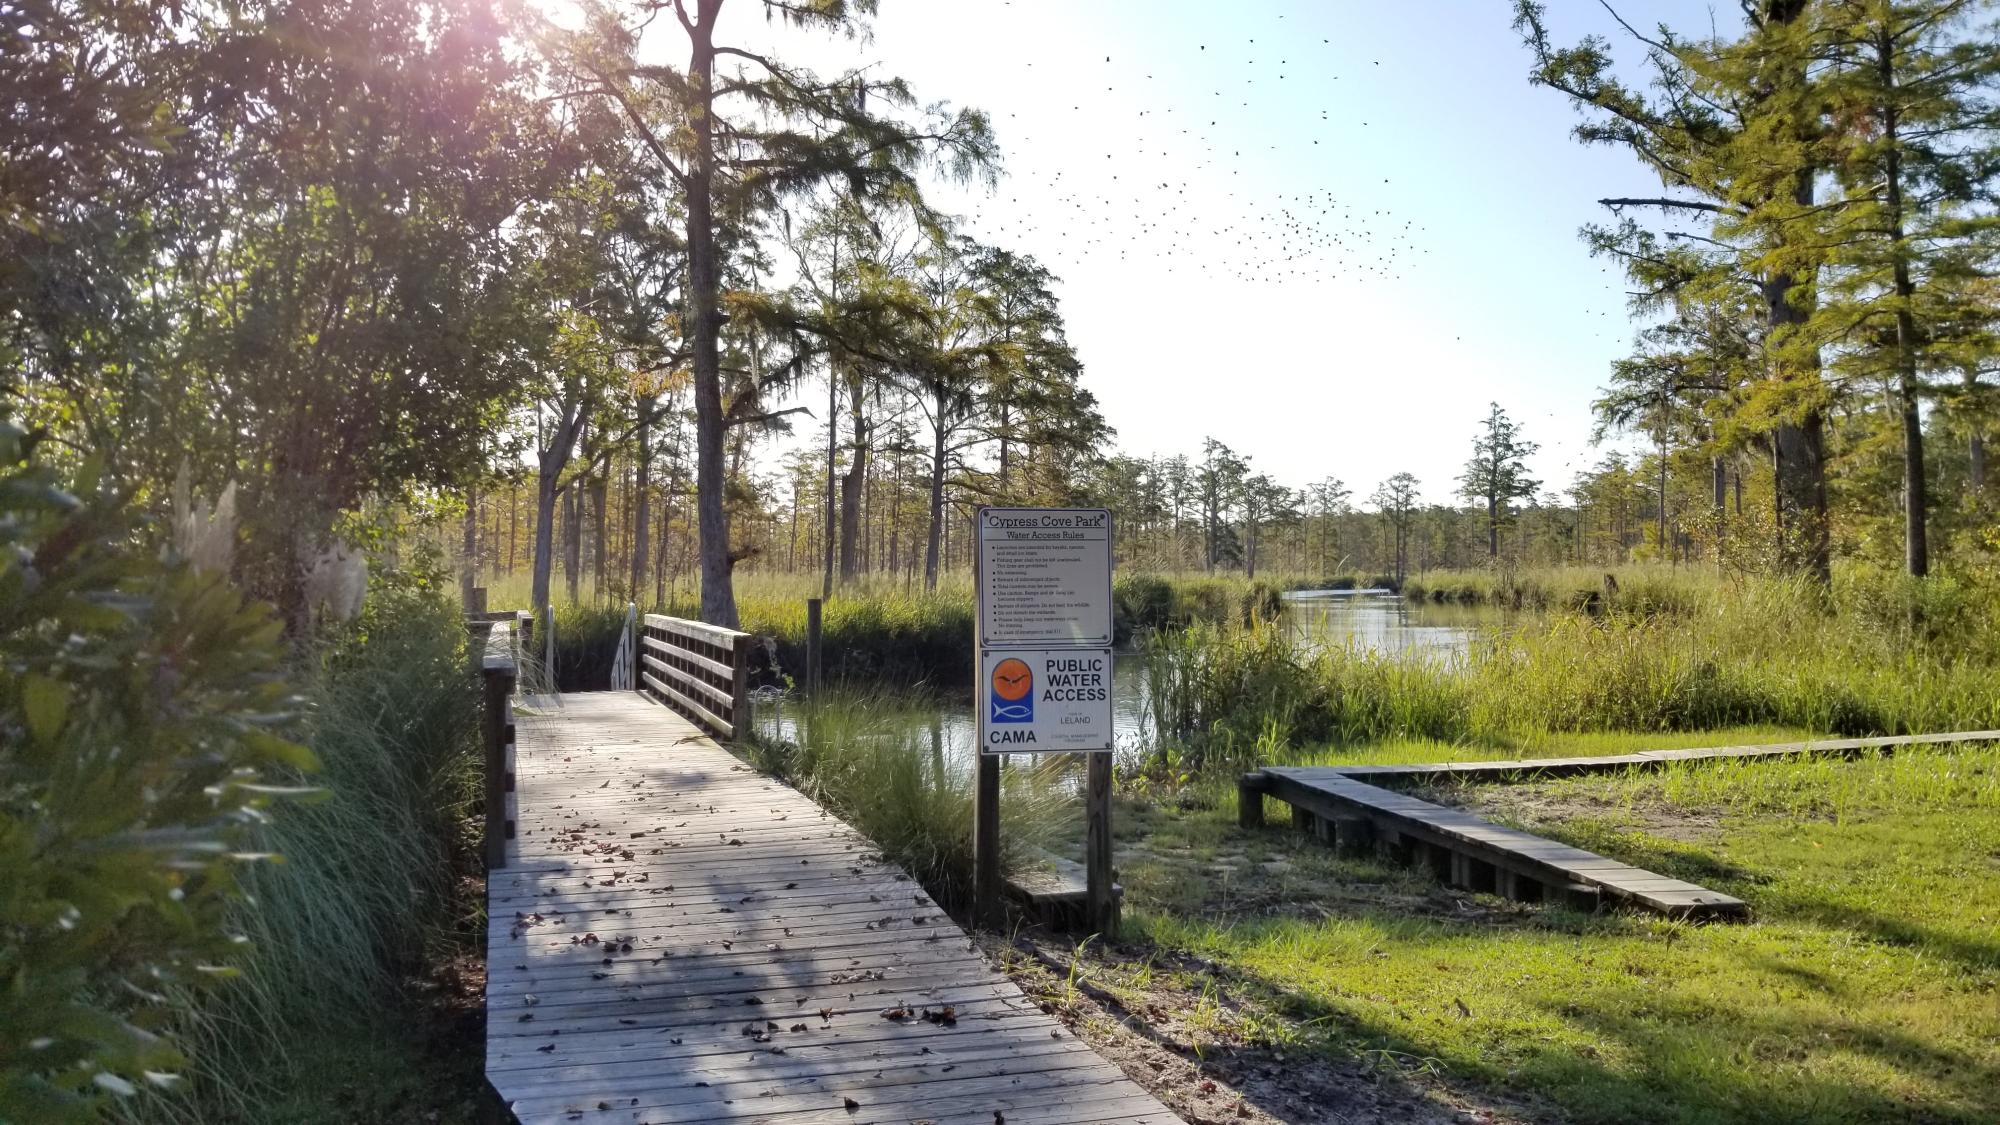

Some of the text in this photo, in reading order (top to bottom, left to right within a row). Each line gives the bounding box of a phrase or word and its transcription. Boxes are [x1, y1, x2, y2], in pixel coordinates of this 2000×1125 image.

[989, 516, 1101, 528] Cypress Cove Park
[1006, 531, 1085, 539] Water Access Rules
[1046, 659, 1102, 672] PUBLIC
[1047, 674, 1101, 687] WATER
[1042, 688, 1106, 702] ACCESS
[1060, 717, 1091, 725] LELAND
[990, 730, 1037, 744] CAMA
